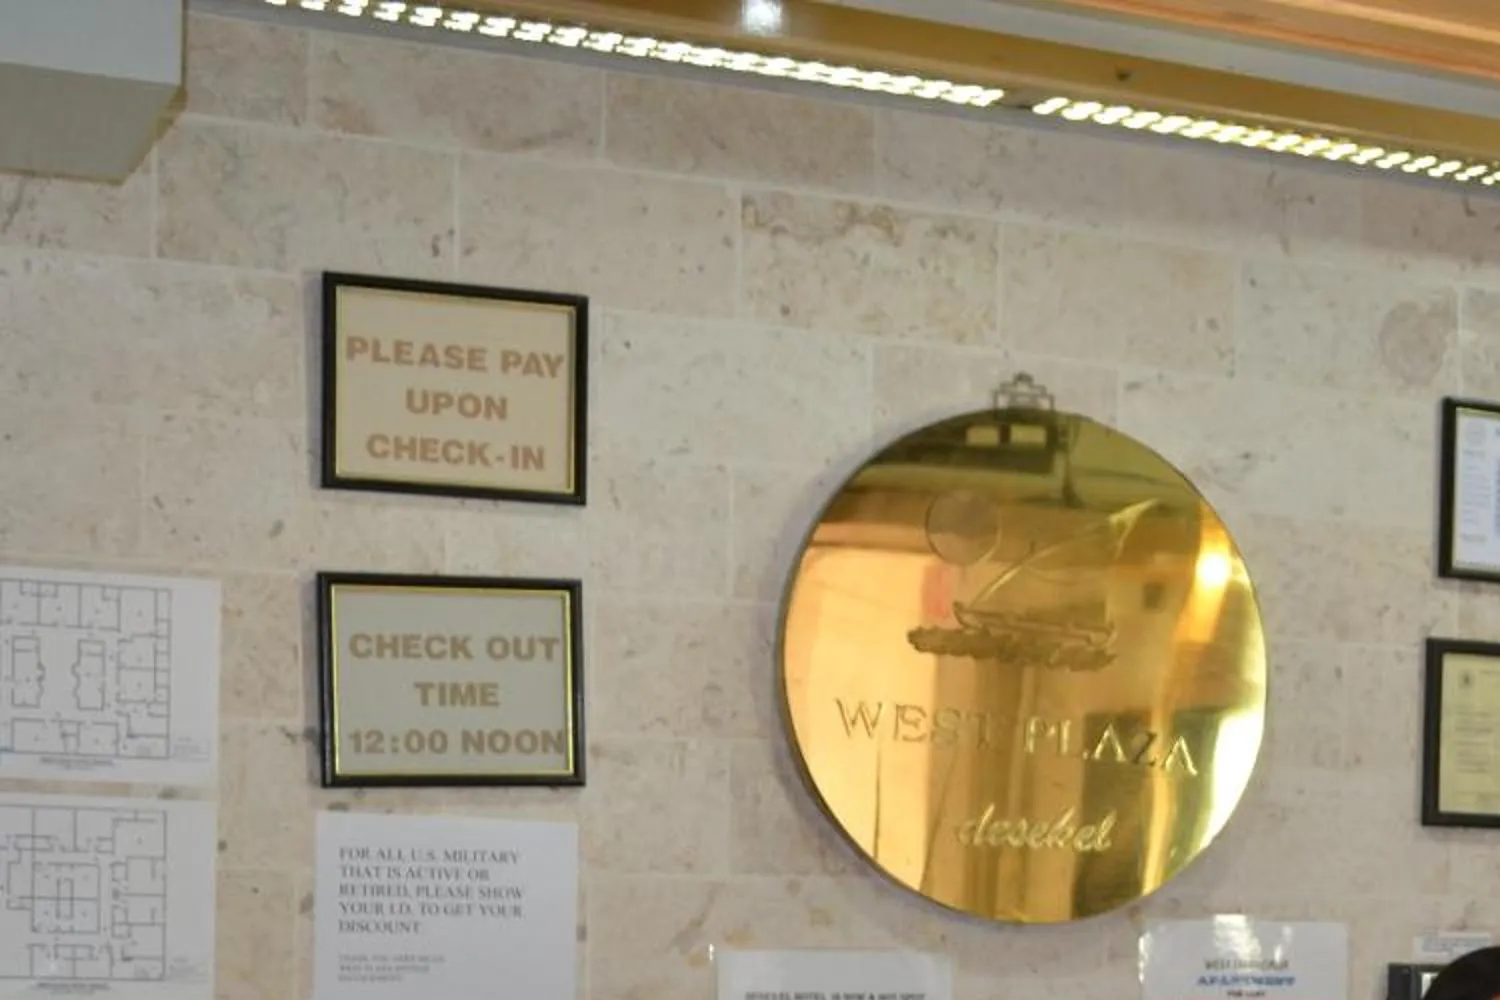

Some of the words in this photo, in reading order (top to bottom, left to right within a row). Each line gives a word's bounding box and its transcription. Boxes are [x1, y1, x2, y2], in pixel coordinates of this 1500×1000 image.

[345, 335, 488, 372] PLEASE
[501, 350, 565, 379] PAY
[405, 388, 509, 421] UPON
[366, 433, 546, 471] CHECK-IN
[348, 632, 474, 660] CHECK
[486, 636, 561, 661] OUT
[414, 681, 500, 707] TIME
[348, 728, 448, 756] 12:00
[461, 728, 565, 757] NOON
[836, 697, 997, 751] WEST
[1023, 714, 1198, 776] PLAZA
[338, 845, 371, 861] FOR
[375, 846, 404, 862] ALL
[443, 847, 521, 865] MILITARY
[340, 864, 382, 880] THAT
[404, 866, 462, 882] ACTIVE
[466, 867, 491, 882] OR
[415, 884, 473, 900] PLEASE
[478, 885, 524, 900] SHOW
[338, 900, 384, 916] YOUR
[420, 902, 440, 917] TO
[442, 902, 474, 917] GET
[478, 902, 524, 919] YOUR
[337, 918, 423, 935] DISCOUNT
